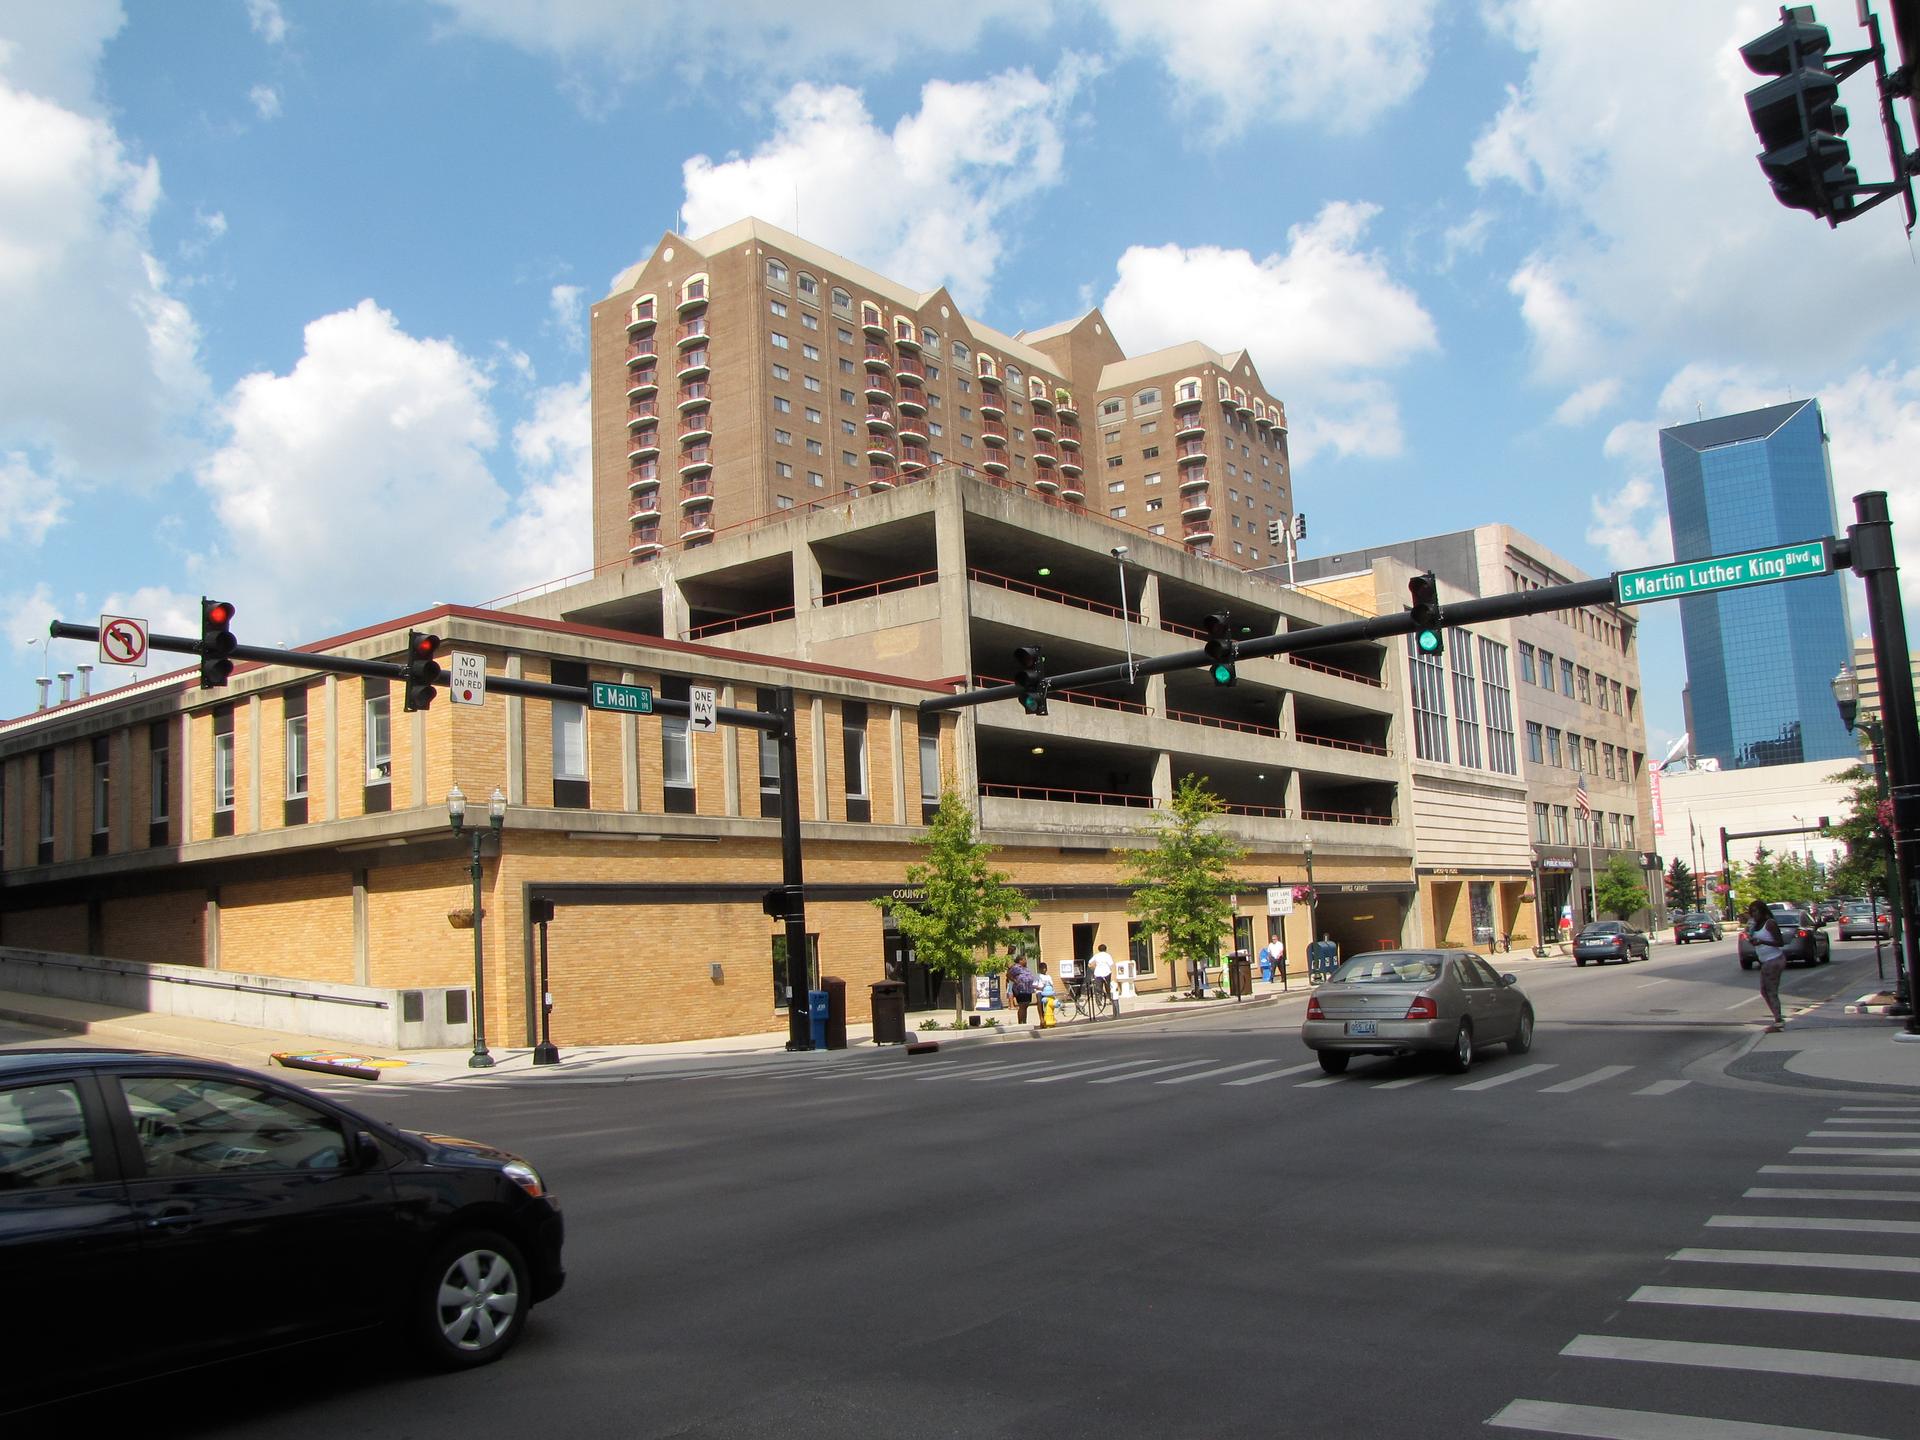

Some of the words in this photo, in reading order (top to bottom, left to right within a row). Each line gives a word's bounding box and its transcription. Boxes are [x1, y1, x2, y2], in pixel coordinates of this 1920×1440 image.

[1624, 584, 1632, 597] S
[1635, 574, 1685, 595] Martin
[1690, 564, 1742, 586] Luther
[1749, 558, 1785, 577] King
[1785, 551, 1809, 565] Blvd
[1811, 555, 1820, 566] N
[461, 656, 476, 667] NO
[459, 668, 479, 679] TURN
[454, 678, 464, 687] ON
[467, 680, 482, 690] RED
[596, 687, 604, 704] E
[608, 688, 637, 708] Main
[641, 691, 649, 701] St
[694, 690, 712, 702] ONE
[694, 702, 713, 713] WAY
